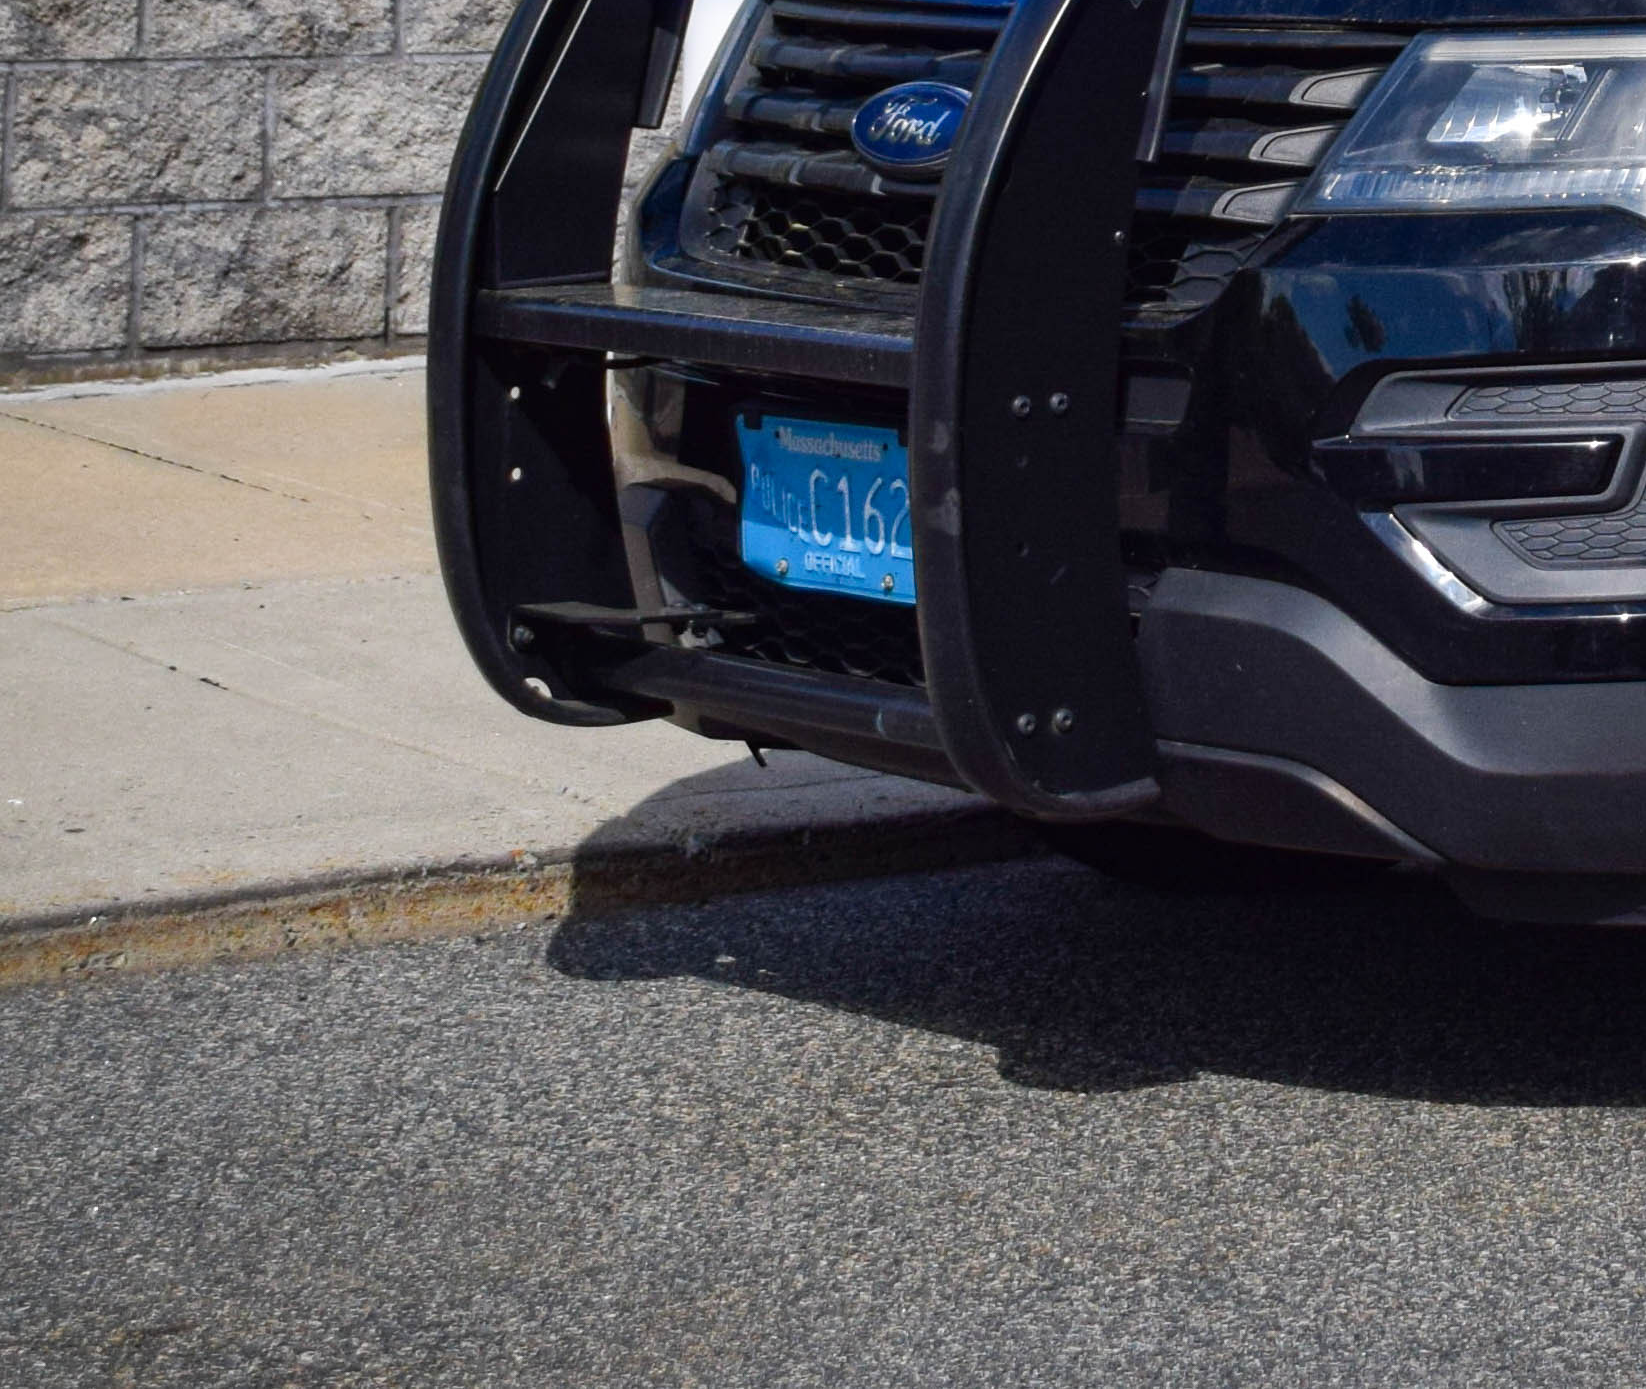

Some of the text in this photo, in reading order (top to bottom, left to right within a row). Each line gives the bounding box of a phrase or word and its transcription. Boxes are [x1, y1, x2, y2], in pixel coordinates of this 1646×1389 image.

[868, 93, 952, 146] Ford
[777, 426, 882, 462] Massachusetts
[809, 468, 912, 560] C162
[804, 550, 866, 579] OFFICIAL
